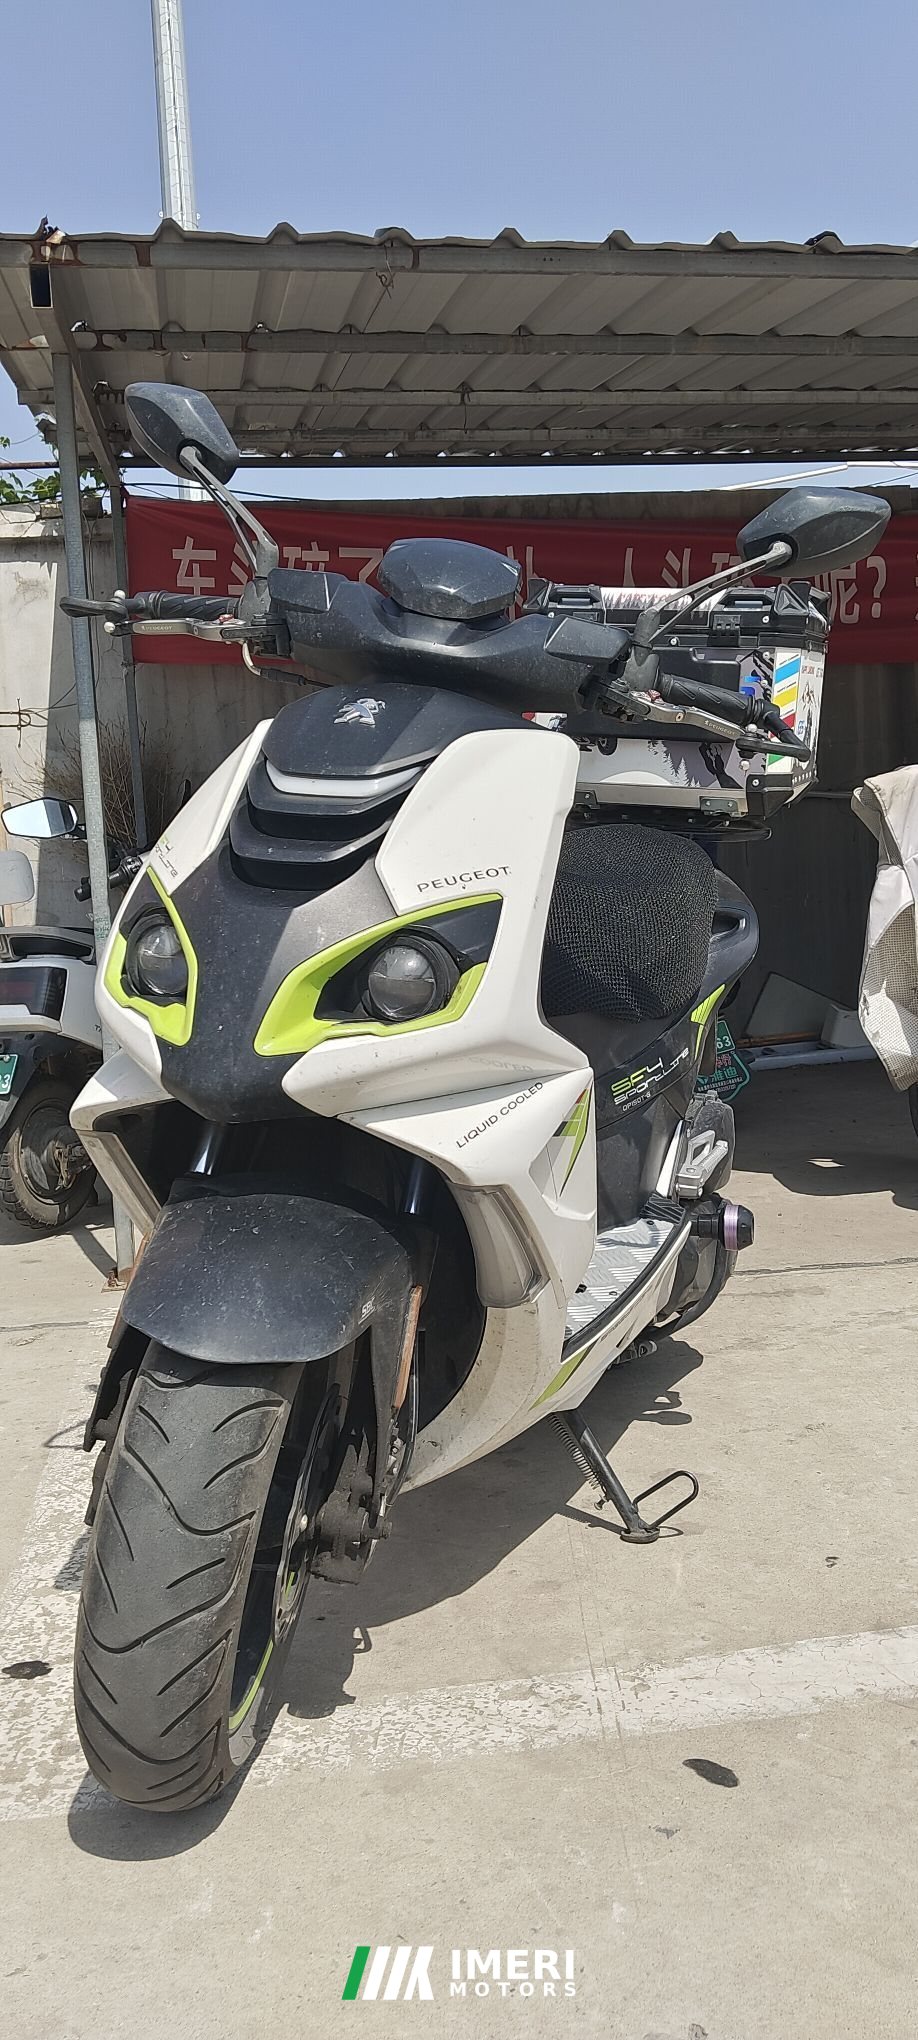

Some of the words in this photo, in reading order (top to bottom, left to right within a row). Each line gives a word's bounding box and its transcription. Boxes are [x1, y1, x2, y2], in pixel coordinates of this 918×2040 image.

[416, 865, 511, 893] PEUGEOT
[611, 1056, 664, 1096] SF4
[456, 1114, 498, 1148] LIQUID
[499, 1081, 544, 1116] COOLED
